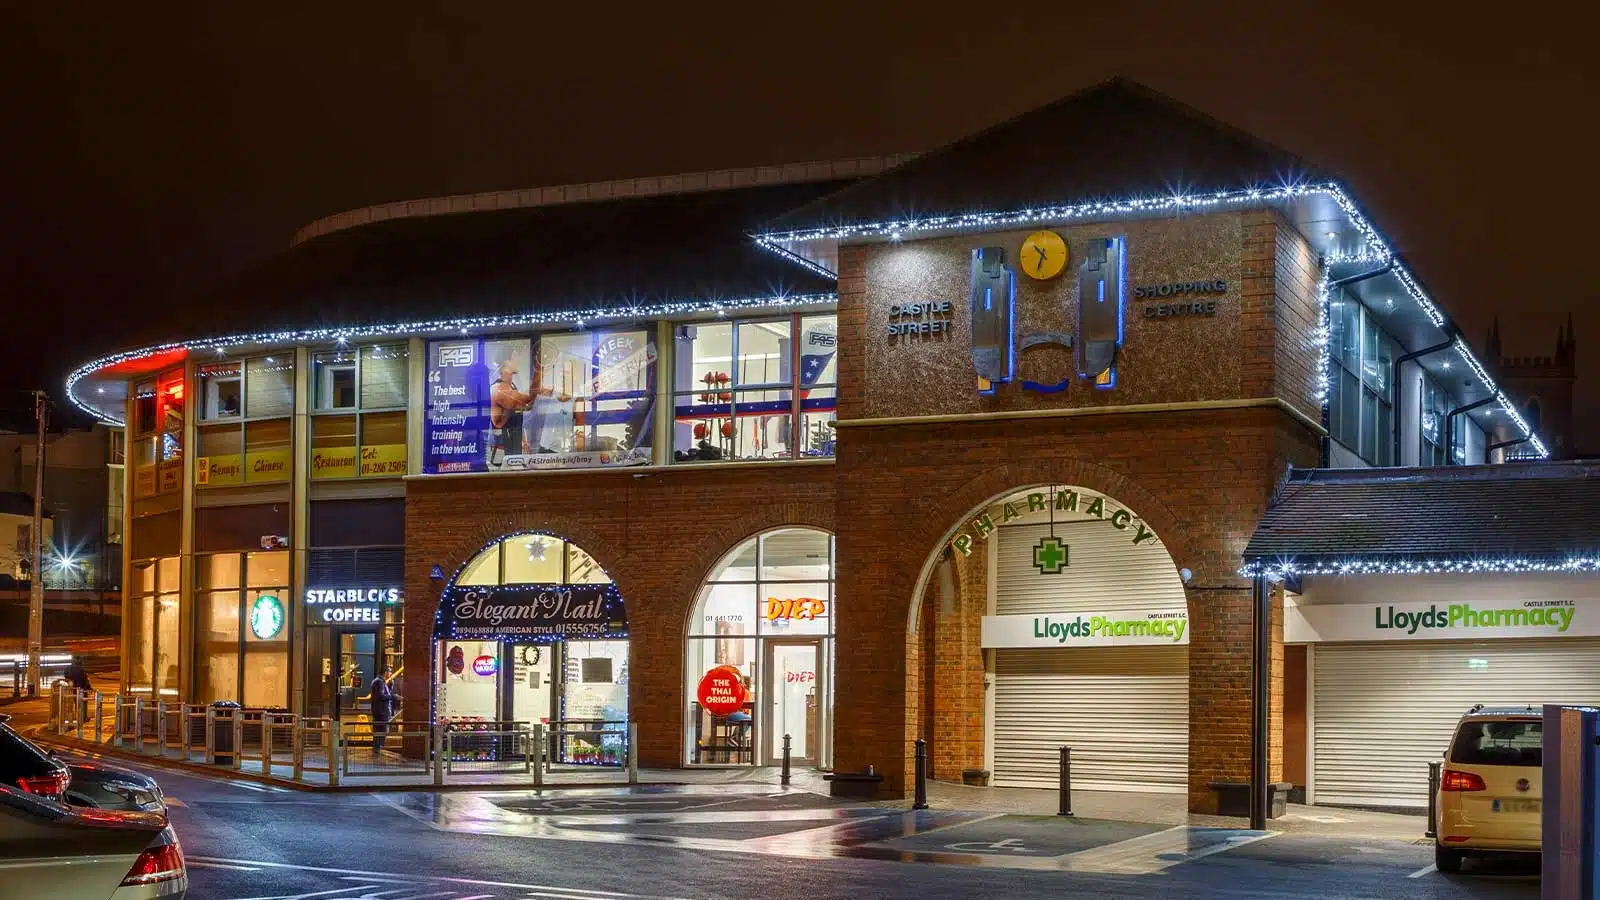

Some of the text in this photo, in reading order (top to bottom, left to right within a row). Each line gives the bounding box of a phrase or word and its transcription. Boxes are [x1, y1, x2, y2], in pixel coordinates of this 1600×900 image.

[1134, 279, 1228, 298] SHOPPING
[889, 300, 951, 317] CASTLE
[1144, 301, 1218, 318] CENTRE
[888, 320, 951, 335] STREET
[809, 331, 835, 347] F45
[596, 337, 633, 359] WEEK
[439, 345, 473, 367] F45
[433, 385, 466, 396] The best
[433, 400, 450, 413] high
[432, 415, 467, 426] intensity
[432, 430, 463, 441] training
[432, 443, 478, 455] in the world.
[253, 458, 285, 473] Chinese
[314, 454, 356, 471] Restaurant
[951, 489, 1159, 557] PHARMACY
[306, 588, 399, 603] STARBUCKS
[323, 607, 380, 621] COFFEE
[455, 590, 602, 625] Elegant Nail
[767, 597, 825, 621] DIEP
[1376, 603, 1575, 635] LloydsPharmacy
[495, 626, 532, 634] AMERICAN
[533, 626, 553, 634] STYLE
[555, 623, 606, 634] 015556756
[1034, 615, 1187, 643] LloydsPharmacy
[787, 671, 816, 683] DIEP
[711, 687, 731, 695] THAI
[706, 696, 736, 704] ORIGIN
